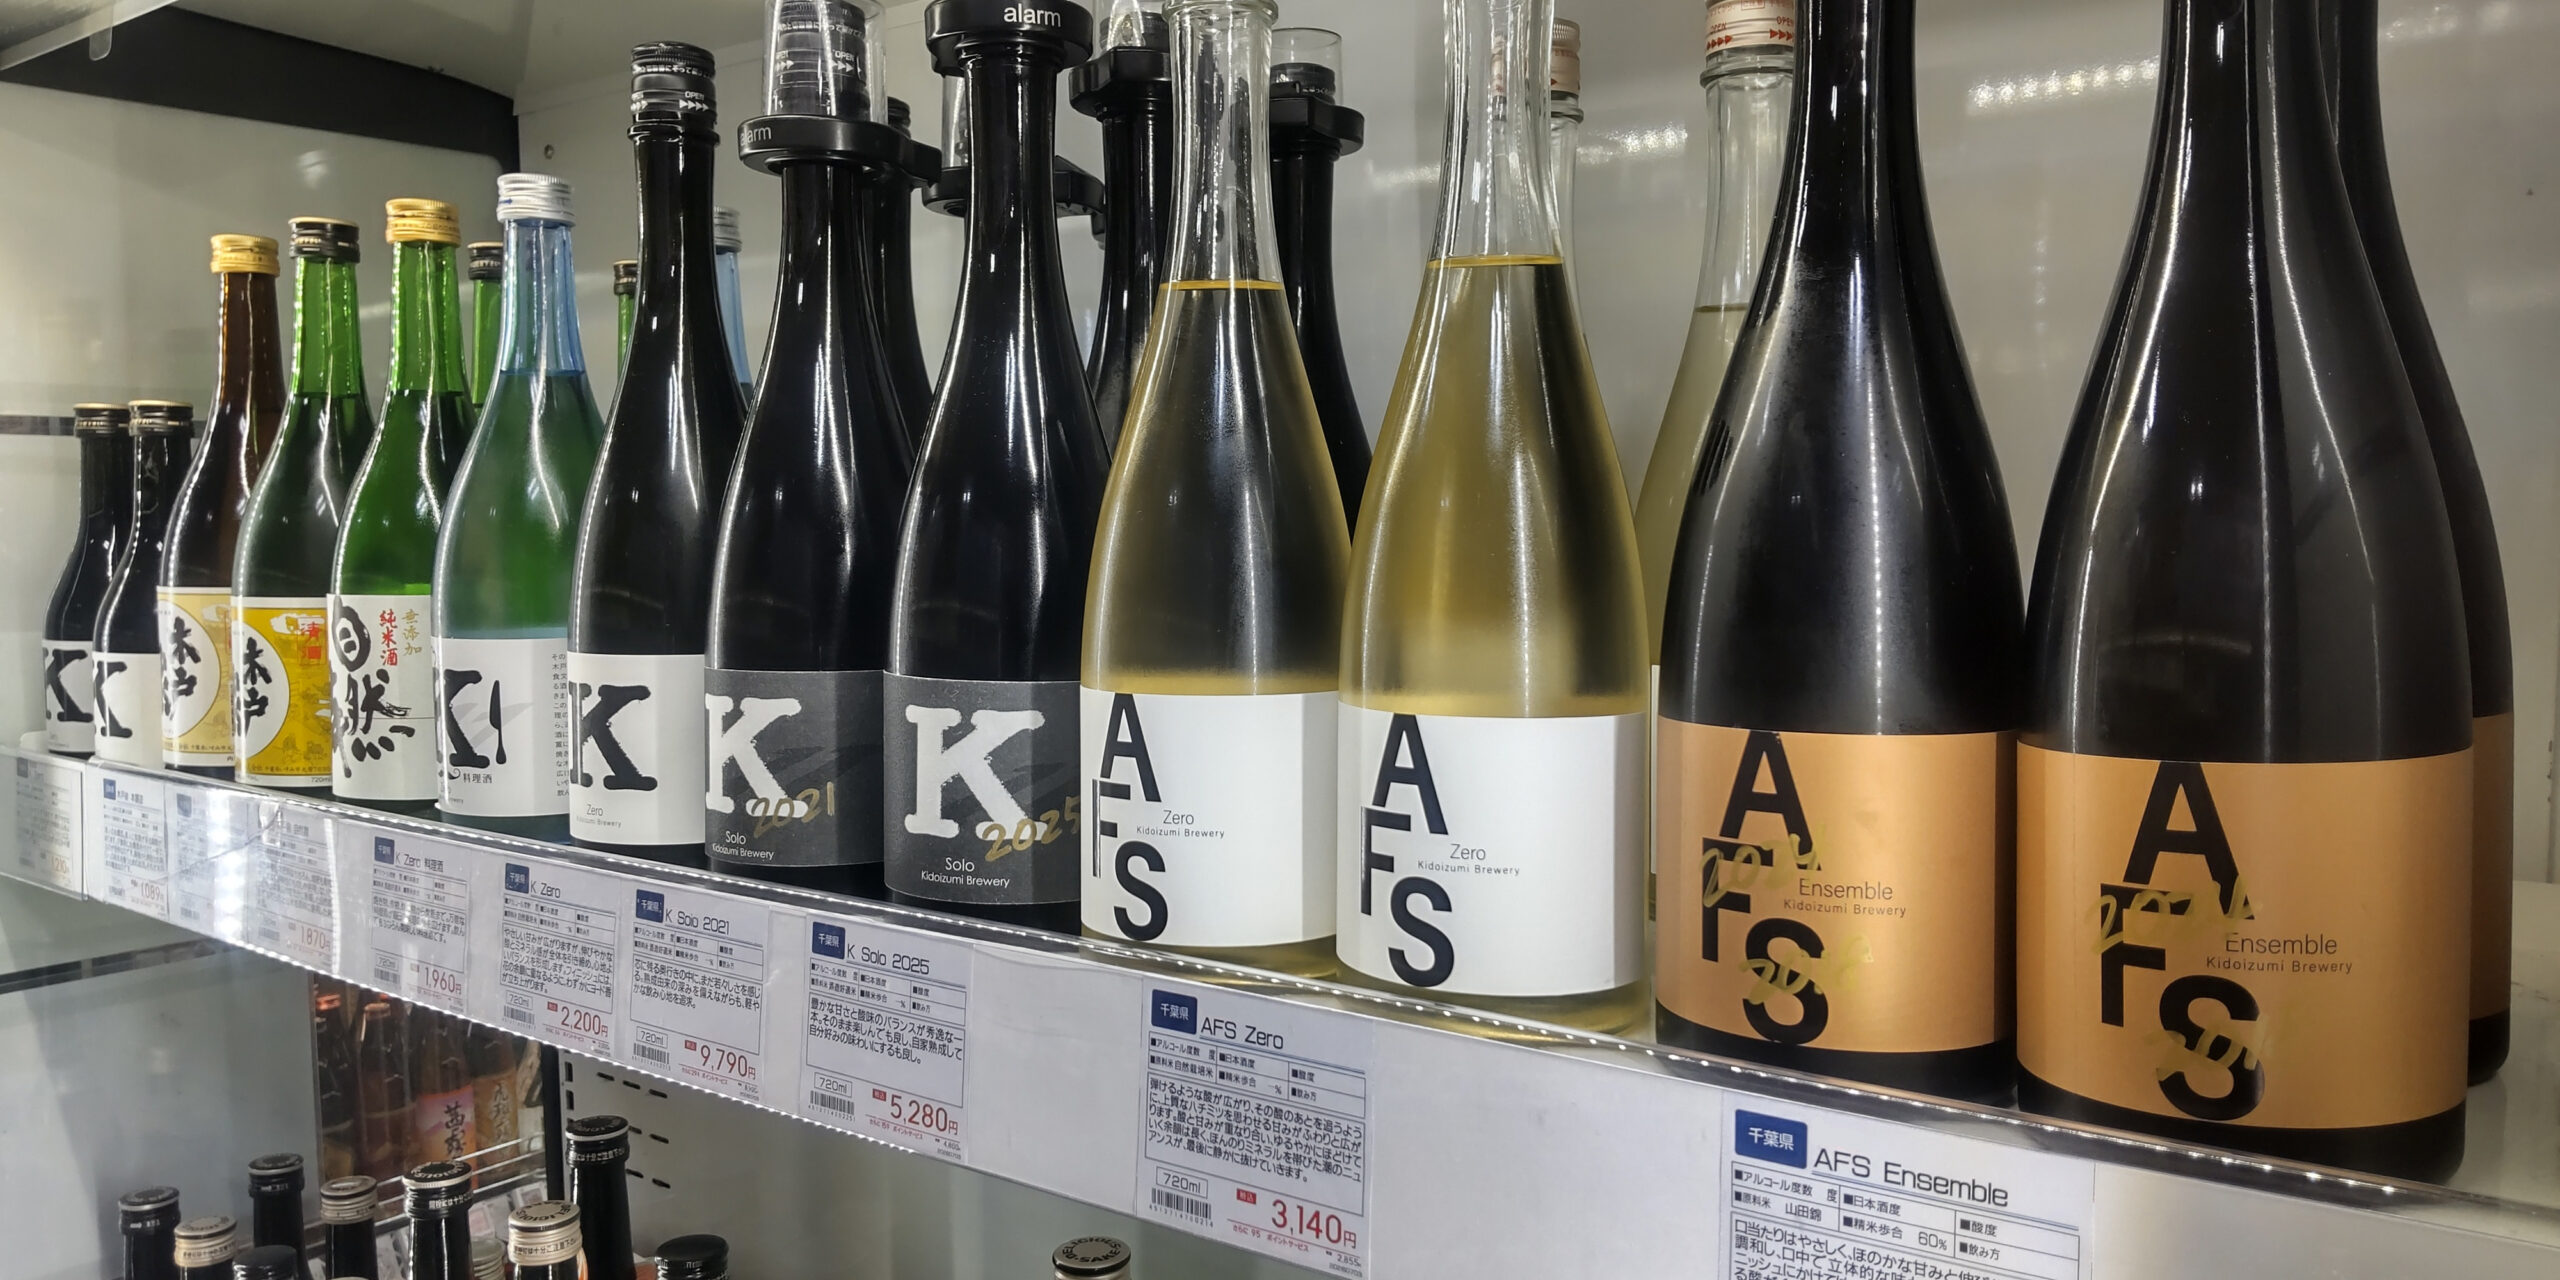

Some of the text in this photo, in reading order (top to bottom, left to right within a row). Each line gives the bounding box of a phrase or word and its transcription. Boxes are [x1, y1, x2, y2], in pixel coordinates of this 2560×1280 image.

[1003, 5, 1061, 28] alarm
[740, 126, 772, 147] alarm
[379, 608, 398, 666] 純米酒
[402, 609, 422, 656] 無添加
[568, 681, 658, 791] K
[705, 693, 802, 818] K
[462, 773, 493, 784] 料理酒
[905, 704, 1046, 839] K
[587, 804, 604, 817] Zero
[749, 781, 836, 838] 2021
[1092, 693, 1169, 942] AFS
[1163, 810, 1195, 825] Zero
[725, 830, 747, 845] Solo
[982, 795, 1081, 862] 2025
[1136, 826, 1225, 839] Kidoizumi Brewery
[404, 853, 421, 868] Zero
[740, 846, 775, 861] Brewery
[1360, 712, 1455, 988] AFS
[1450, 843, 1486, 861] Zero
[945, 857, 975, 873] Solo
[1417, 860, 1520, 876] Kidoizumi Brewery
[530, 880, 561, 899] K Zero
[921, 870, 1010, 888] Kidoizumi Brewery
[1799, 878, 1893, 901] Ensemble
[1783, 899, 1907, 918] Kidoizumi Brewery
[666, 908, 730, 936] K Solo 2021
[818, 933, 839, 947] 千葉県
[2225, 933, 2338, 955] Ensemble
[847, 943, 930, 975] K Solo 2025
[2206, 956, 2353, 974] Kidoizumi Brewery
[560, 1004, 608, 1039] 2,200円
[1160, 1003, 1189, 1020] 千葉県
[640, 1029, 663, 1045] 720ml
[1201, 1016, 1283, 1050] AFS Zero
[1155, 1037, 1200, 1056] アルコール度数
[700, 1043, 756, 1083] 9,790円
[1225, 1052, 1255, 1069] 日本酒度
[819, 1076, 847, 1094] 720ml
[889, 1093, 958, 1138] 5,280円
[1748, 1127, 1794, 1151] 千葉県
[1163, 1171, 1201, 1194] 720ml
[1743, 1170, 1838, 1203] アルコール度数 度
[1814, 1148, 2009, 1207] AFS Ensemble
[1743, 1191, 1822, 1222] 原料米 山田錦
[1853, 1194, 1901, 1217] 日本酒度
[1271, 1197, 1356, 1252] 3,140円
[1853, 1217, 1948, 1251] 精米歩合 60%
[1971, 1220, 1997, 1237] 酸度
[1968, 1243, 2000, 1261] 飲み方
